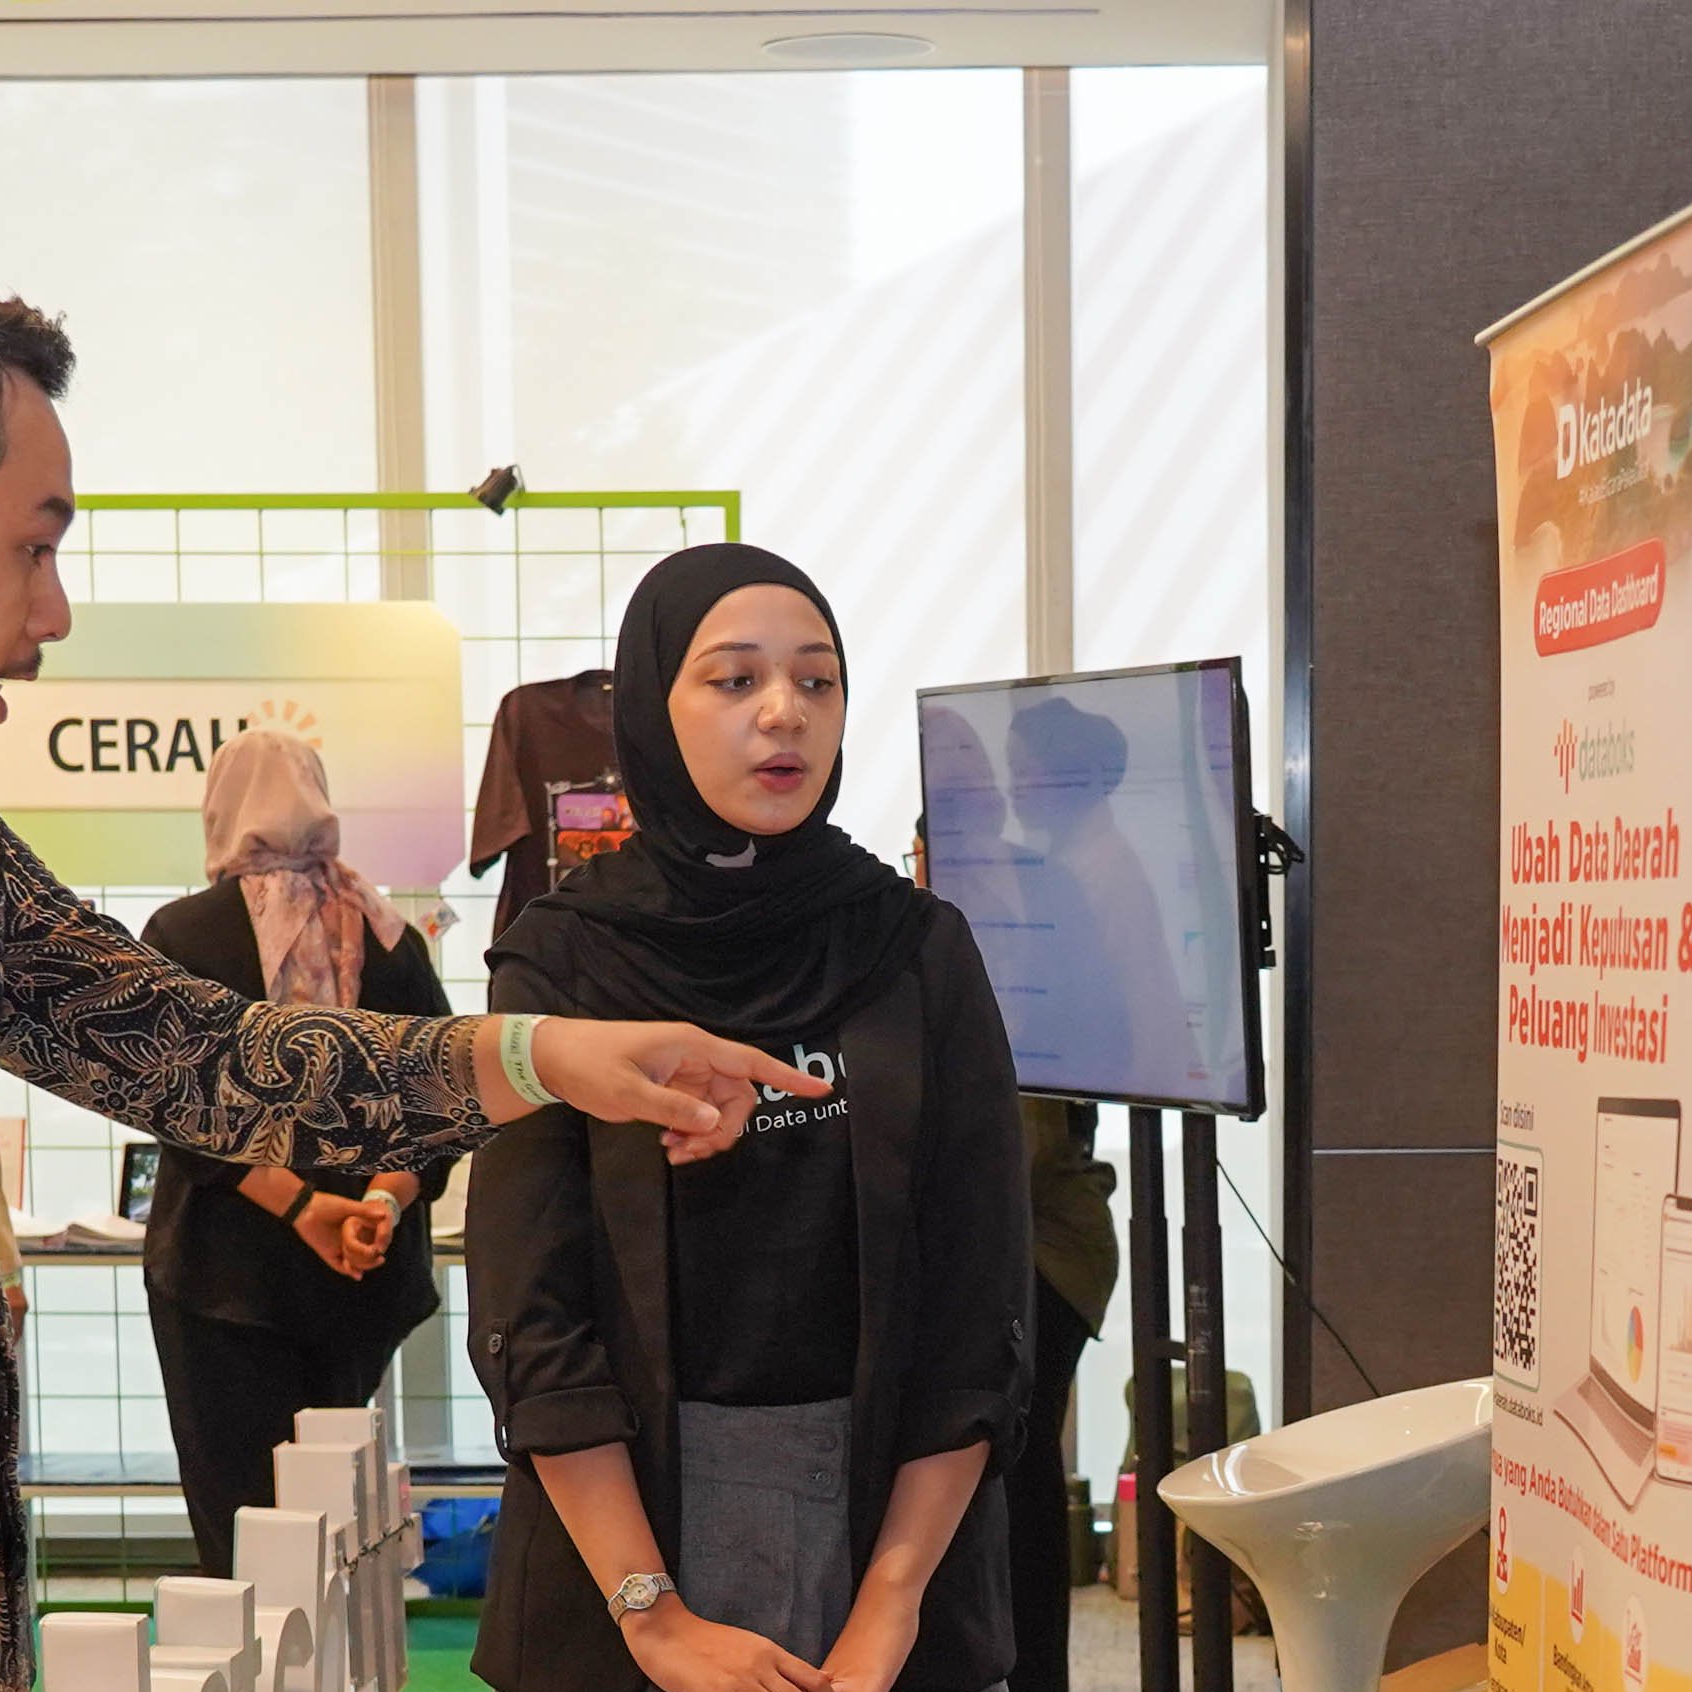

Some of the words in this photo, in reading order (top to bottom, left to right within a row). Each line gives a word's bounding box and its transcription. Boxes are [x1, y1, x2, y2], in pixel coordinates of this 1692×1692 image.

[1579, 376, 1653, 467] katadata
[1539, 596, 1588, 639] Regional
[1589, 587, 1610, 625] Data
[1611, 562, 1660, 618] Dashboard
[1511, 819, 1561, 884] Ubah
[1567, 820, 1610, 883] Data
[1612, 807, 1680, 882] Daerah
[1502, 902, 1573, 977] Menjadi
[1579, 903, 1669, 981] Keputusan
[1509, 984, 1589, 1064] Peluang
[1592, 990, 1669, 1064] Investasi
[755, 1110, 807, 1132] Data
[814, 1098, 848, 1120] unt
[1504, 1456, 1527, 1496] yang
[1529, 1464, 1557, 1504] Anda
